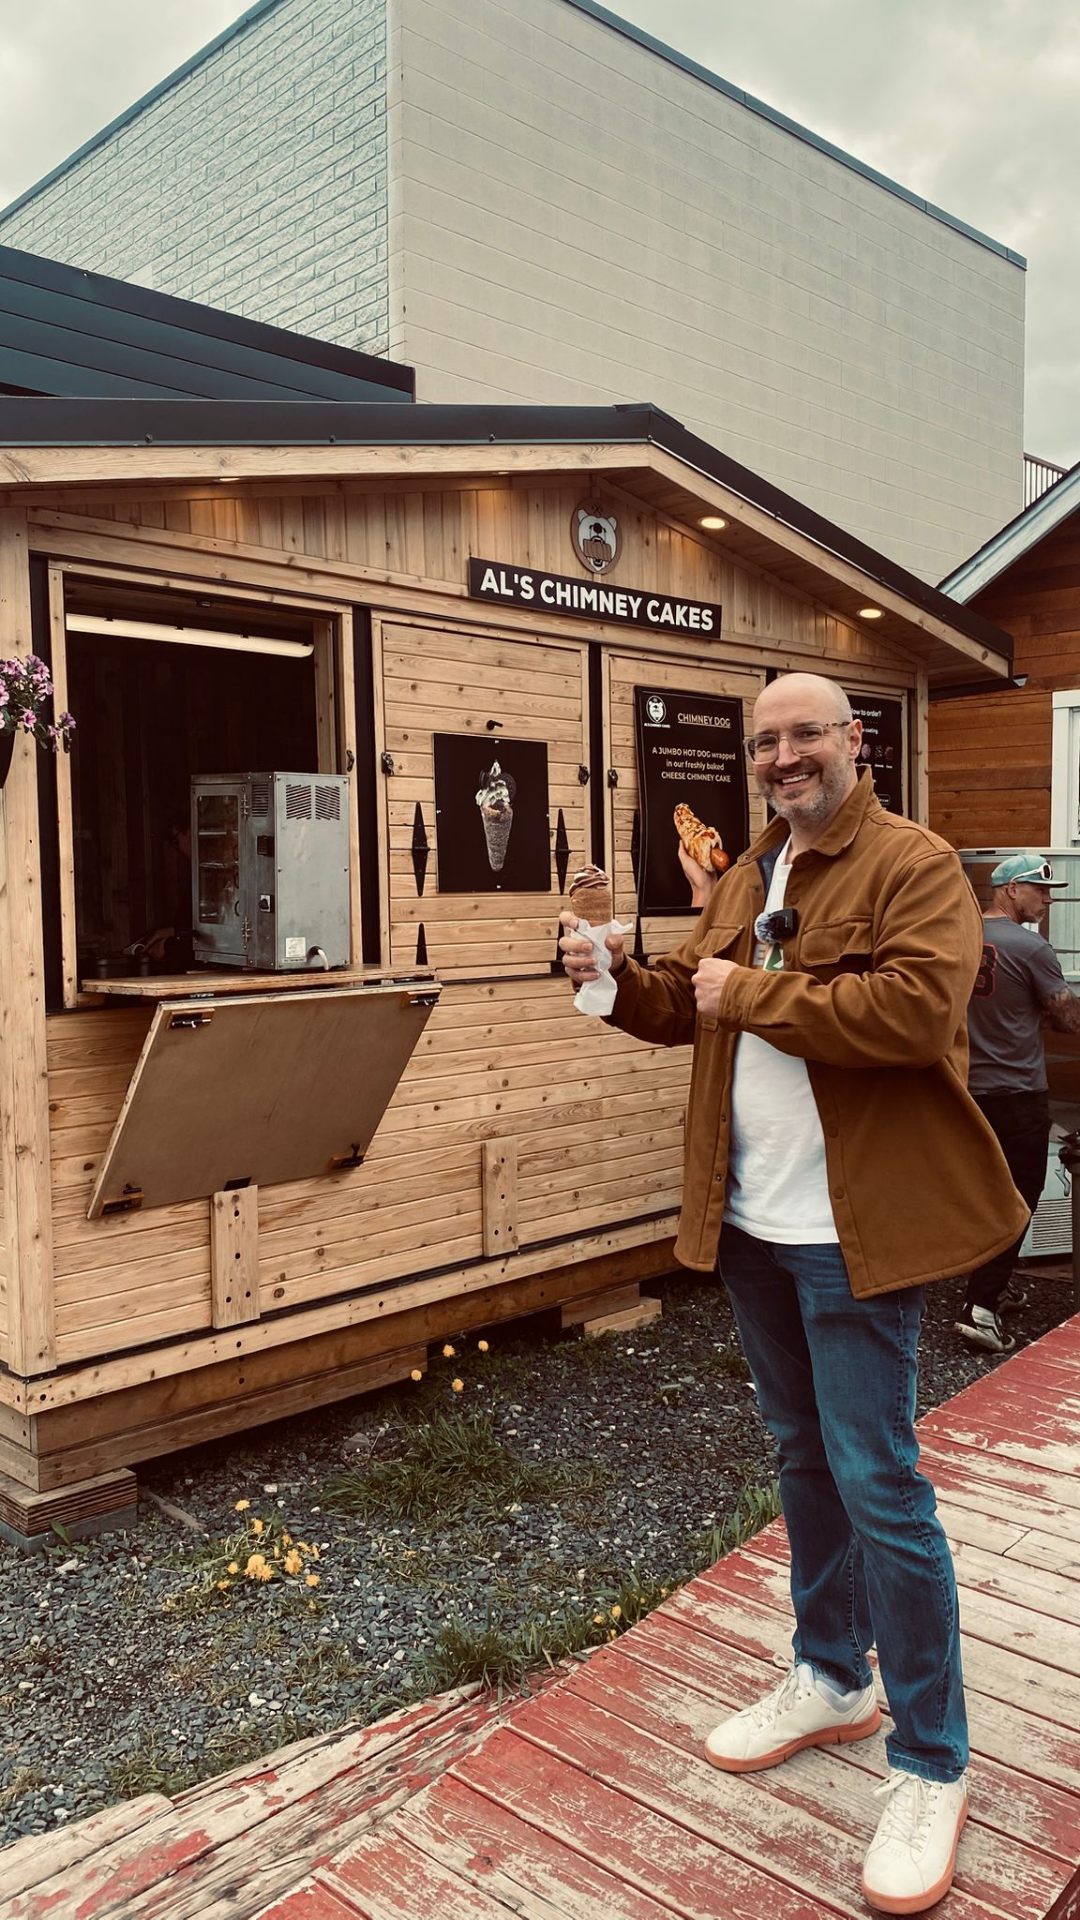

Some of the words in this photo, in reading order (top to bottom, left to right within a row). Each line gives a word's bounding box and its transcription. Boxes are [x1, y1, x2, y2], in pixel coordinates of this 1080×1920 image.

[480, 568, 535, 600] AL'S
[540, 579, 642, 619] CHIMNEY
[646, 600, 714, 631] CAKES
[677, 713, 713, 725] CHIMNEY
[714, 717, 731, 727] DOG
[652, 746, 658, 755] A
[658, 746, 682, 756] JUMBO
[683, 748, 696, 757] HOT
[696, 750, 711, 758] DOG
[711, 752, 736, 761] wrapped
[666, 759, 673, 767] in
[685, 760, 706, 771] freshly
[706, 763, 725, 771] baked
[661, 771, 686, 780] CHEESE
[686, 772, 715, 782] CHIMNEY
[715, 774, 731, 783] CAKE
